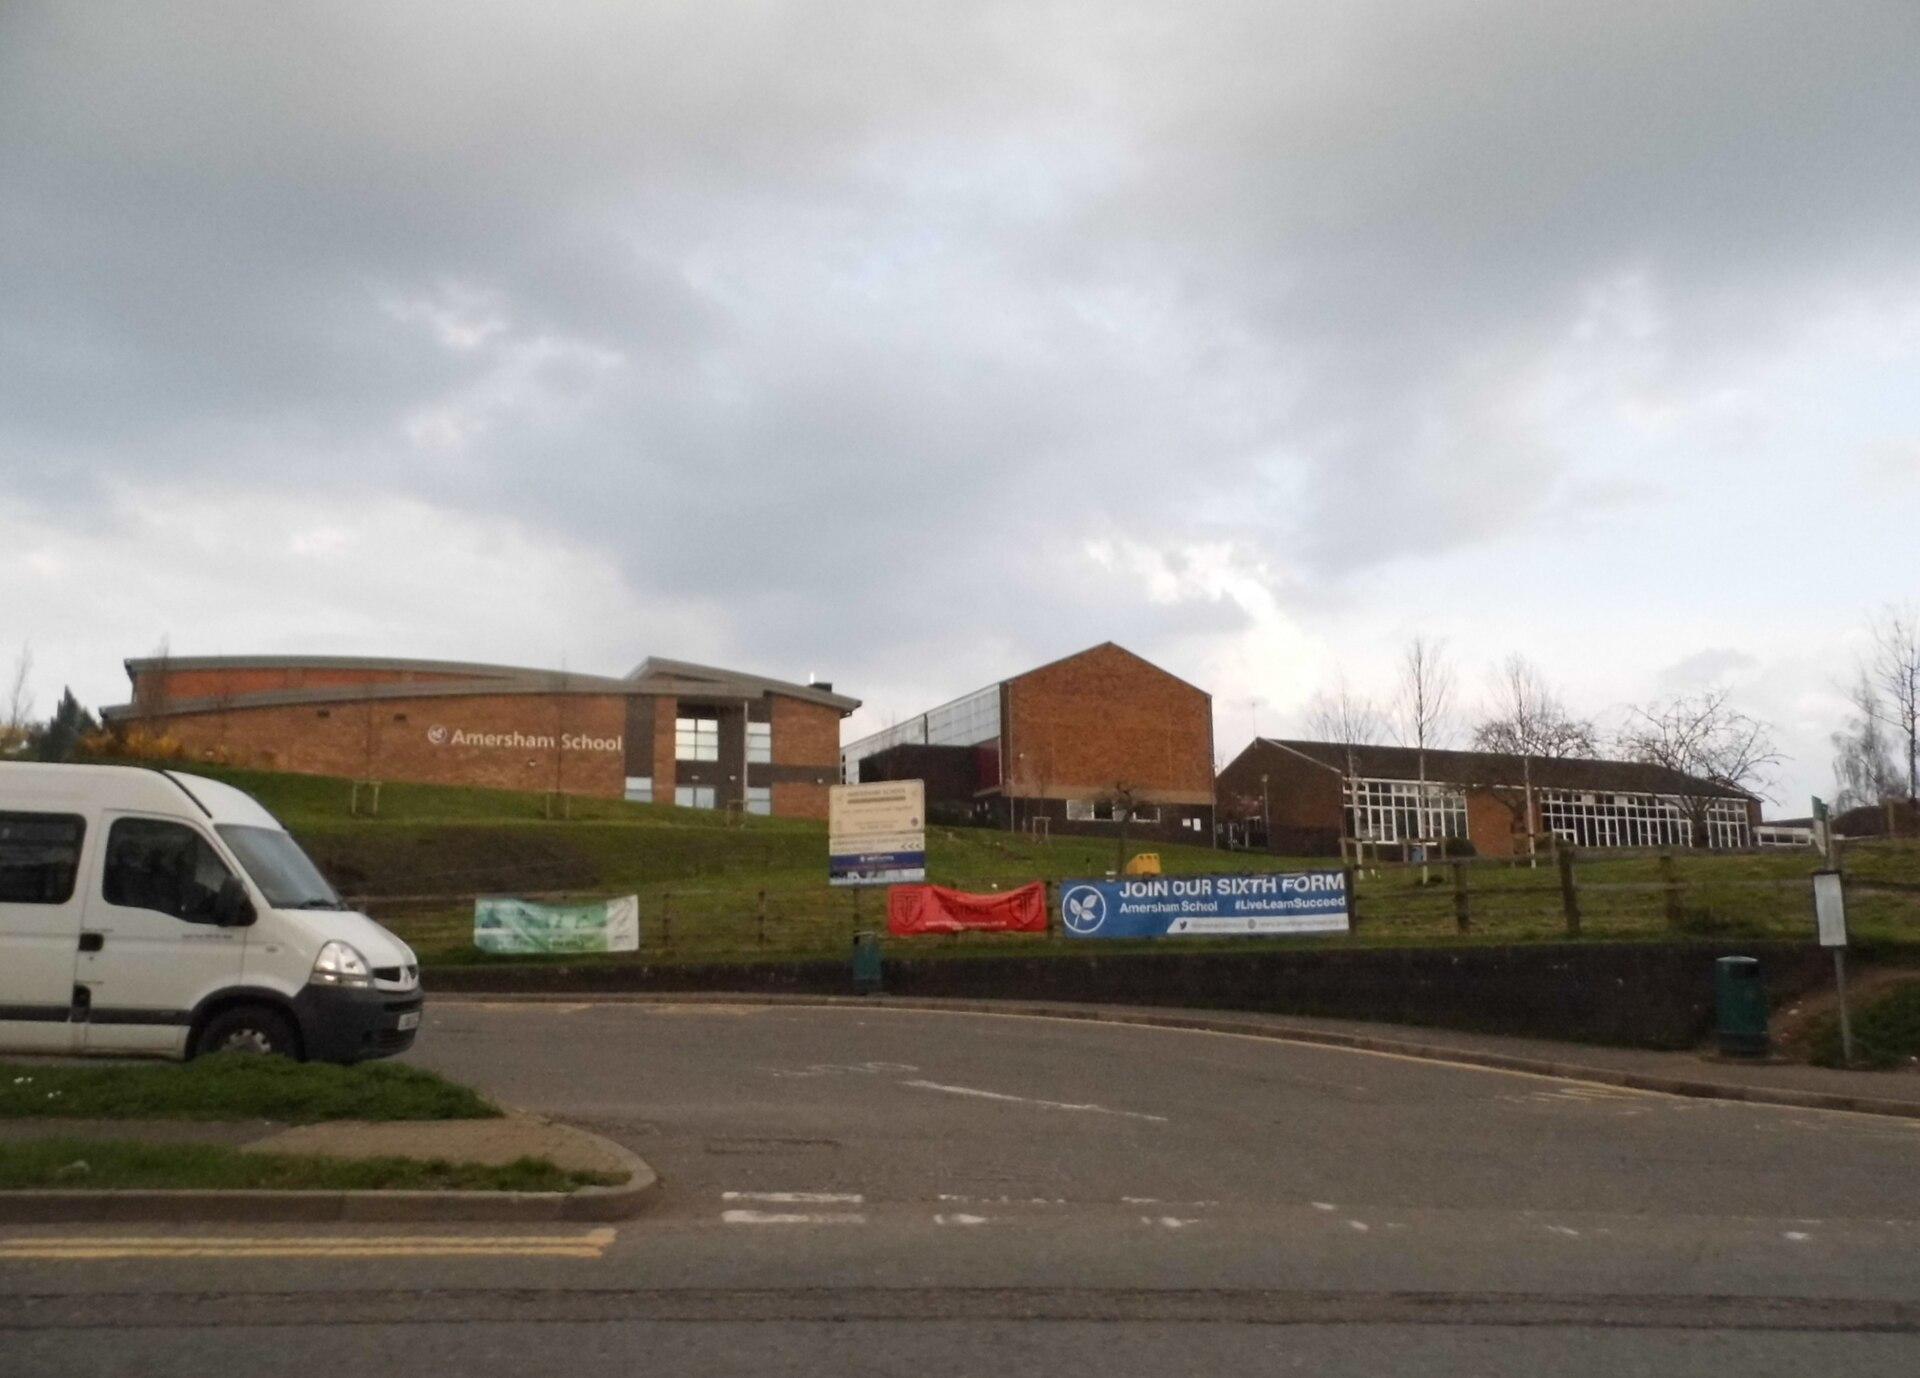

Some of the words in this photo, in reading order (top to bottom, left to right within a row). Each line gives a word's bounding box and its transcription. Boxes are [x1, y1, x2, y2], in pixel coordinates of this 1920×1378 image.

[451, 729, 554, 748] Amersham
[561, 733, 622, 750] School
[1119, 881, 1168, 897] JOIN
[1172, 879, 1212, 896] OUR
[1217, 878, 1277, 894] SIXTH
[1282, 873, 1345, 892] FORM
[1120, 903, 1180, 913] Amersham
[1181, 901, 1218, 912] School
